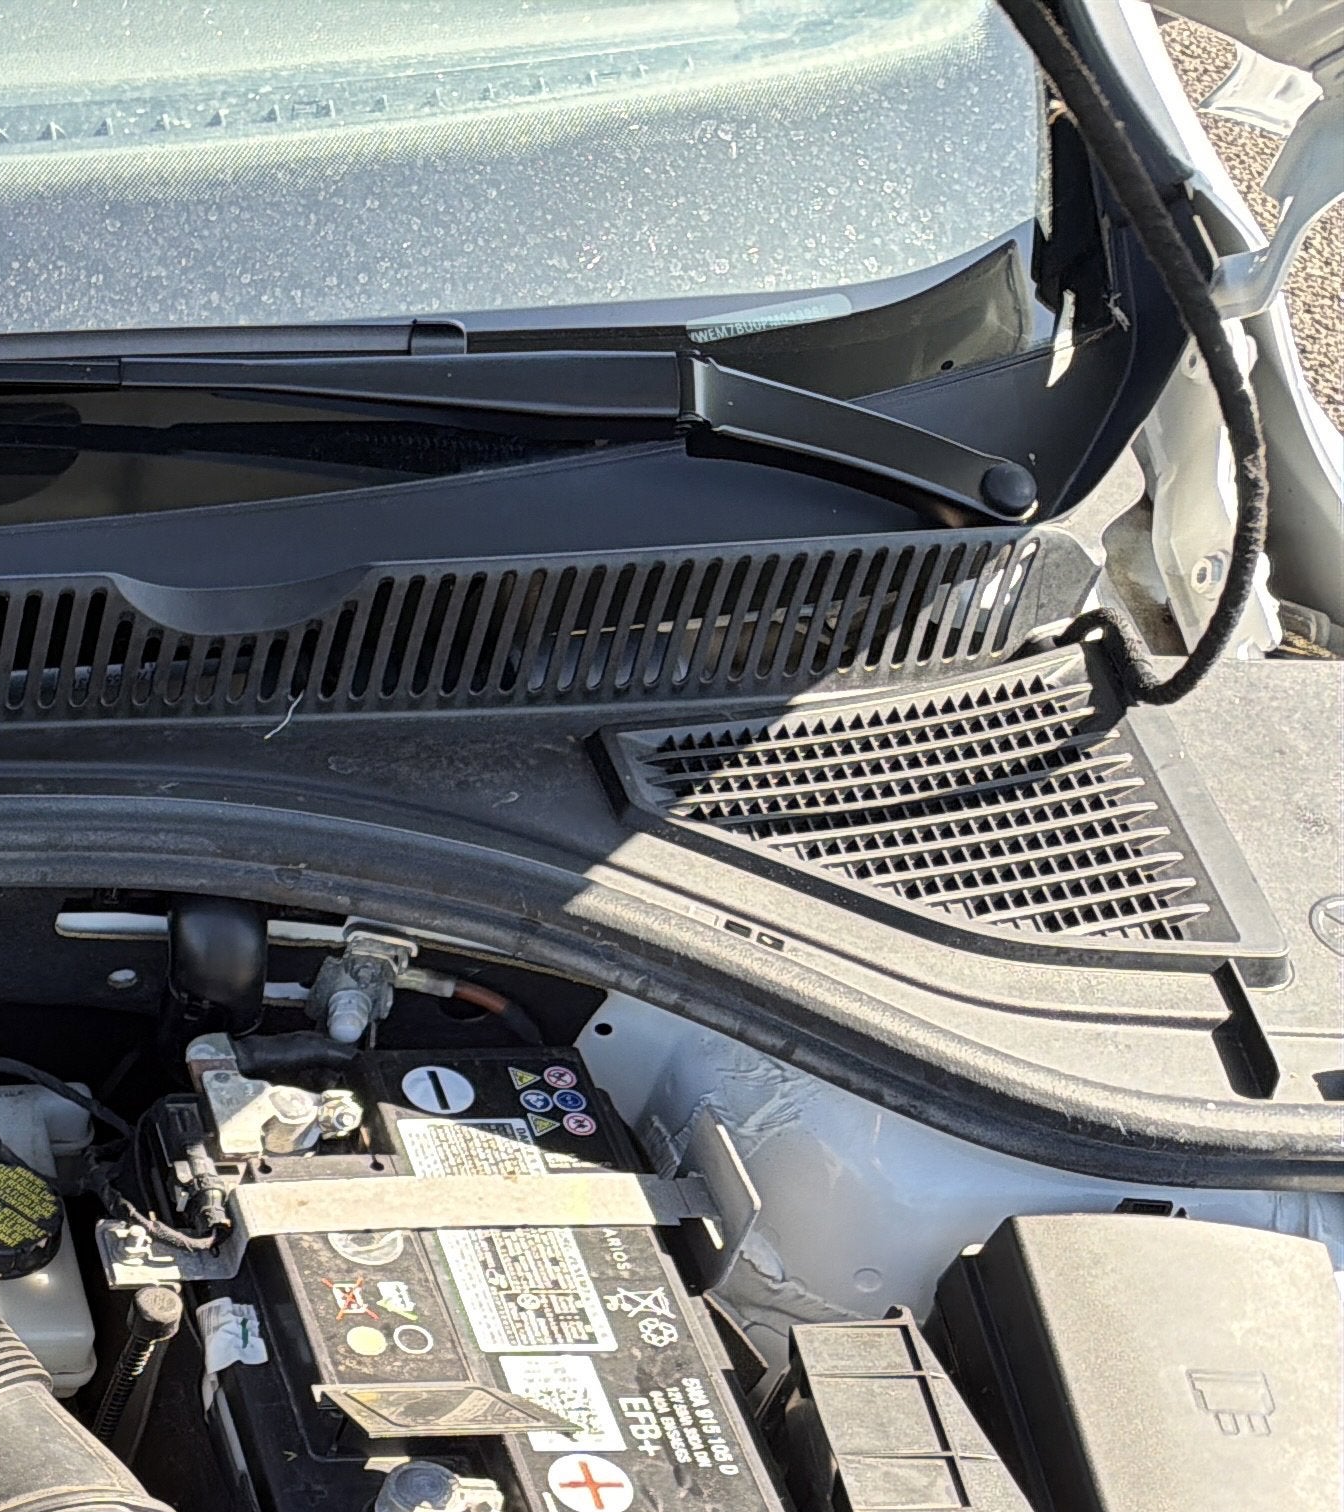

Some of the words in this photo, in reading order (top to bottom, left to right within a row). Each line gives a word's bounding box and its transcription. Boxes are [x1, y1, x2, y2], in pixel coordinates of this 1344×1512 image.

[602, 1227, 633, 1270] ARIOS
[618, 1397, 662, 1457] EFB+
[695, 1408, 722, 1434] 915
[707, 1436, 734, 1462] 105
